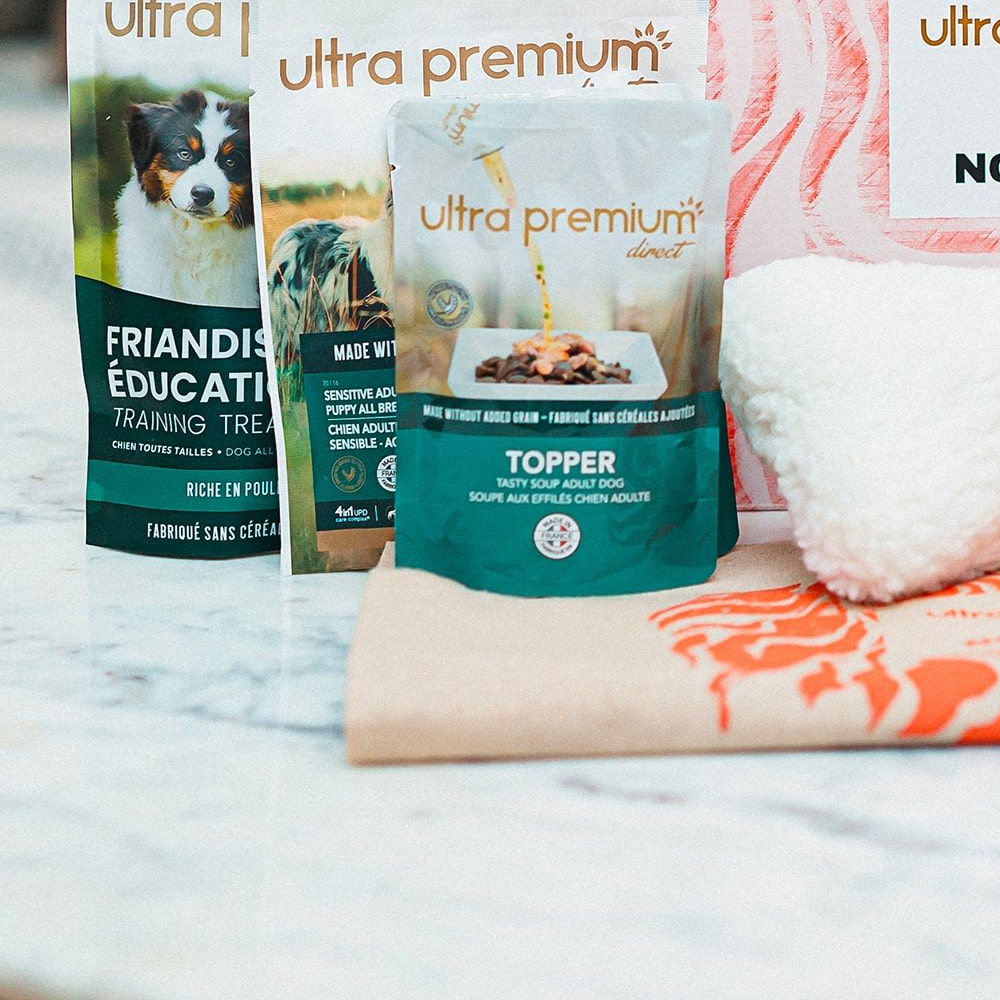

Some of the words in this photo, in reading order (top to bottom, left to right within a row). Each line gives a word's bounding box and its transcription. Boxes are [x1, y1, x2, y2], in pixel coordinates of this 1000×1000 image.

[279, 37, 403, 91] ultra
[422, 32, 659, 97] premium
[420, 194, 510, 232] ultra
[524, 202, 696, 248] premium
[626, 238, 695, 260] direct
[107, 325, 266, 359] FRIANDIS
[333, 343, 370, 361] MADE
[107, 358, 271, 403] ÉDUCATI
[324, 388, 374, 401] SENSITIVE
[325, 403, 357, 416] PUPPY
[358, 403, 377, 415] ALL
[423, 404, 443, 419] MADE
[444, 407, 482, 422] WITHOUT
[592, 411, 616, 424] SANS
[113, 407, 206, 435] TRAINING
[328, 423, 360, 435] CHIEN
[362, 421, 397, 434] ADULT
[112, 440, 137, 451] CHIEN
[139, 443, 173, 454] TOUTES
[174, 446, 213, 457] TAILLES
[226, 447, 251, 456] DOG
[254, 446, 274, 456] ALL
[329, 437, 378, 451] SENSIBLE
[505, 450, 617, 475] TOPPER
[186, 481, 222, 498] RICHE
[226, 482, 241, 498] EN
[245, 481, 279, 497] POUL
[496, 478, 528, 489] TASTY
[530, 478, 561, 489] SOUP
[562, 478, 596, 489] ADULT
[598, 478, 625, 489] DOG
[469, 491, 504, 503] SOUPE
[506, 493, 529, 504] AUX
[531, 492, 572, 505] EFFILÉS
[574, 493, 608, 504] CHIEN
[610, 491, 651, 504] ADULTE
[147, 521, 200, 541] FABRIQUÉ
[204, 526, 236, 541] SANS
